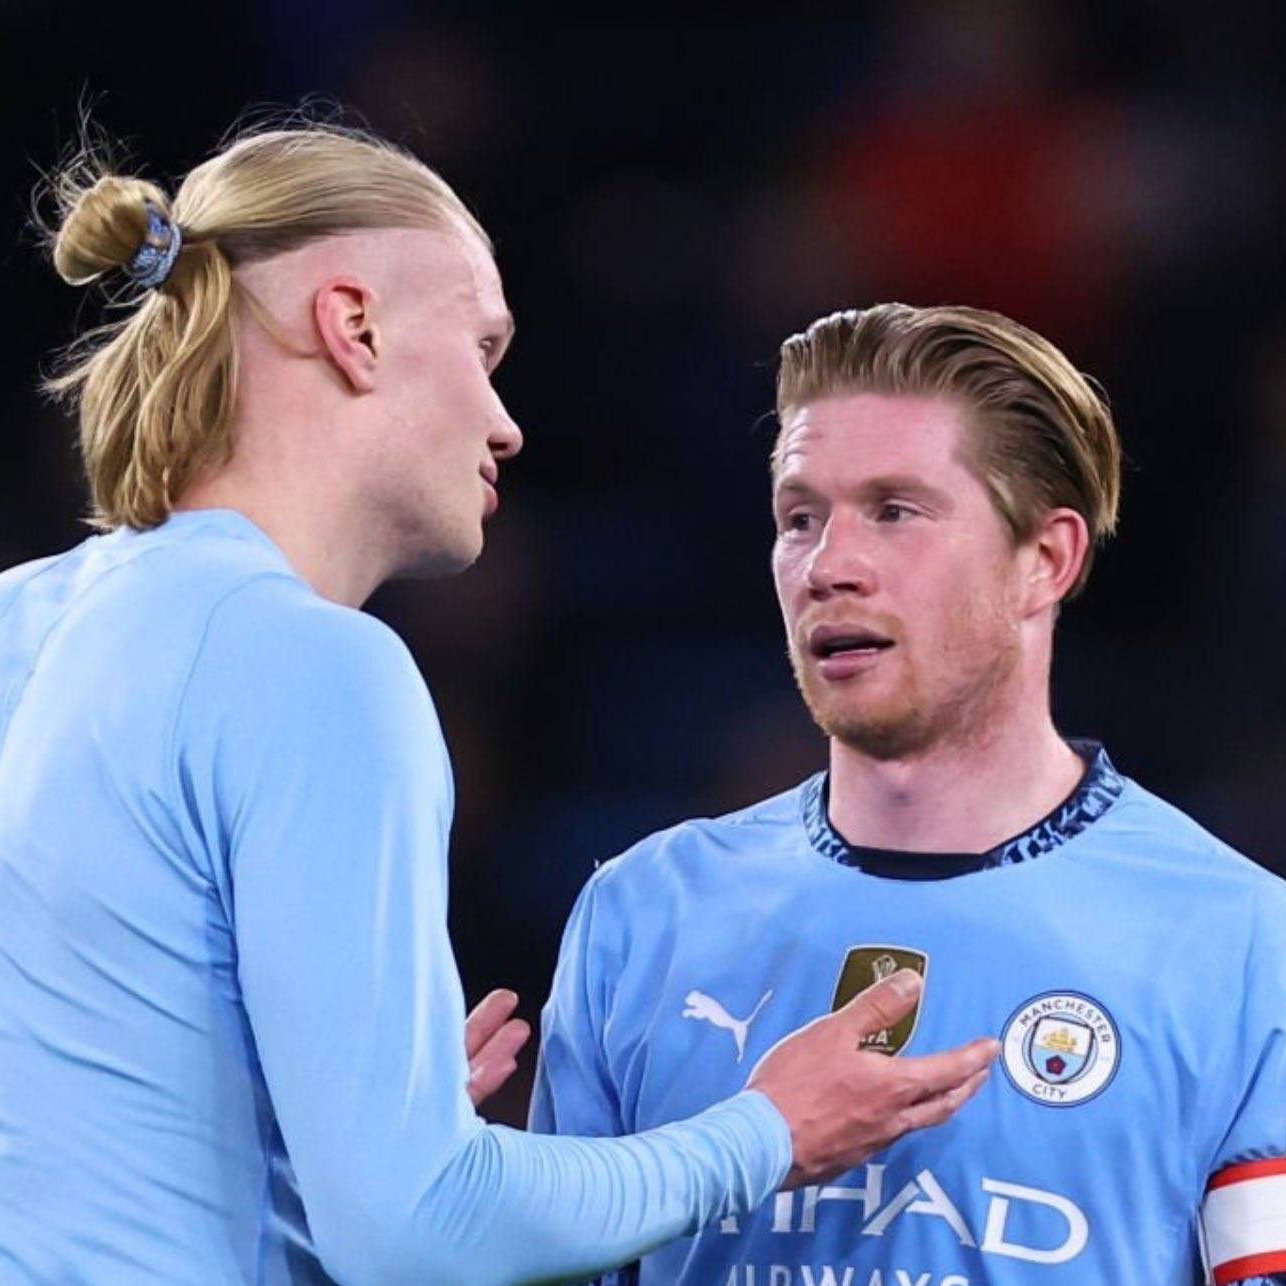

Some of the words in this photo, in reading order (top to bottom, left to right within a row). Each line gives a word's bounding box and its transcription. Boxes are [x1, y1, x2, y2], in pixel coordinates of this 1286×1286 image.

[1019, 999, 1112, 1044] MANCHESTER
[1031, 1083, 1070, 1101] CITY
[720, 1163, 1089, 1265] IHAD
